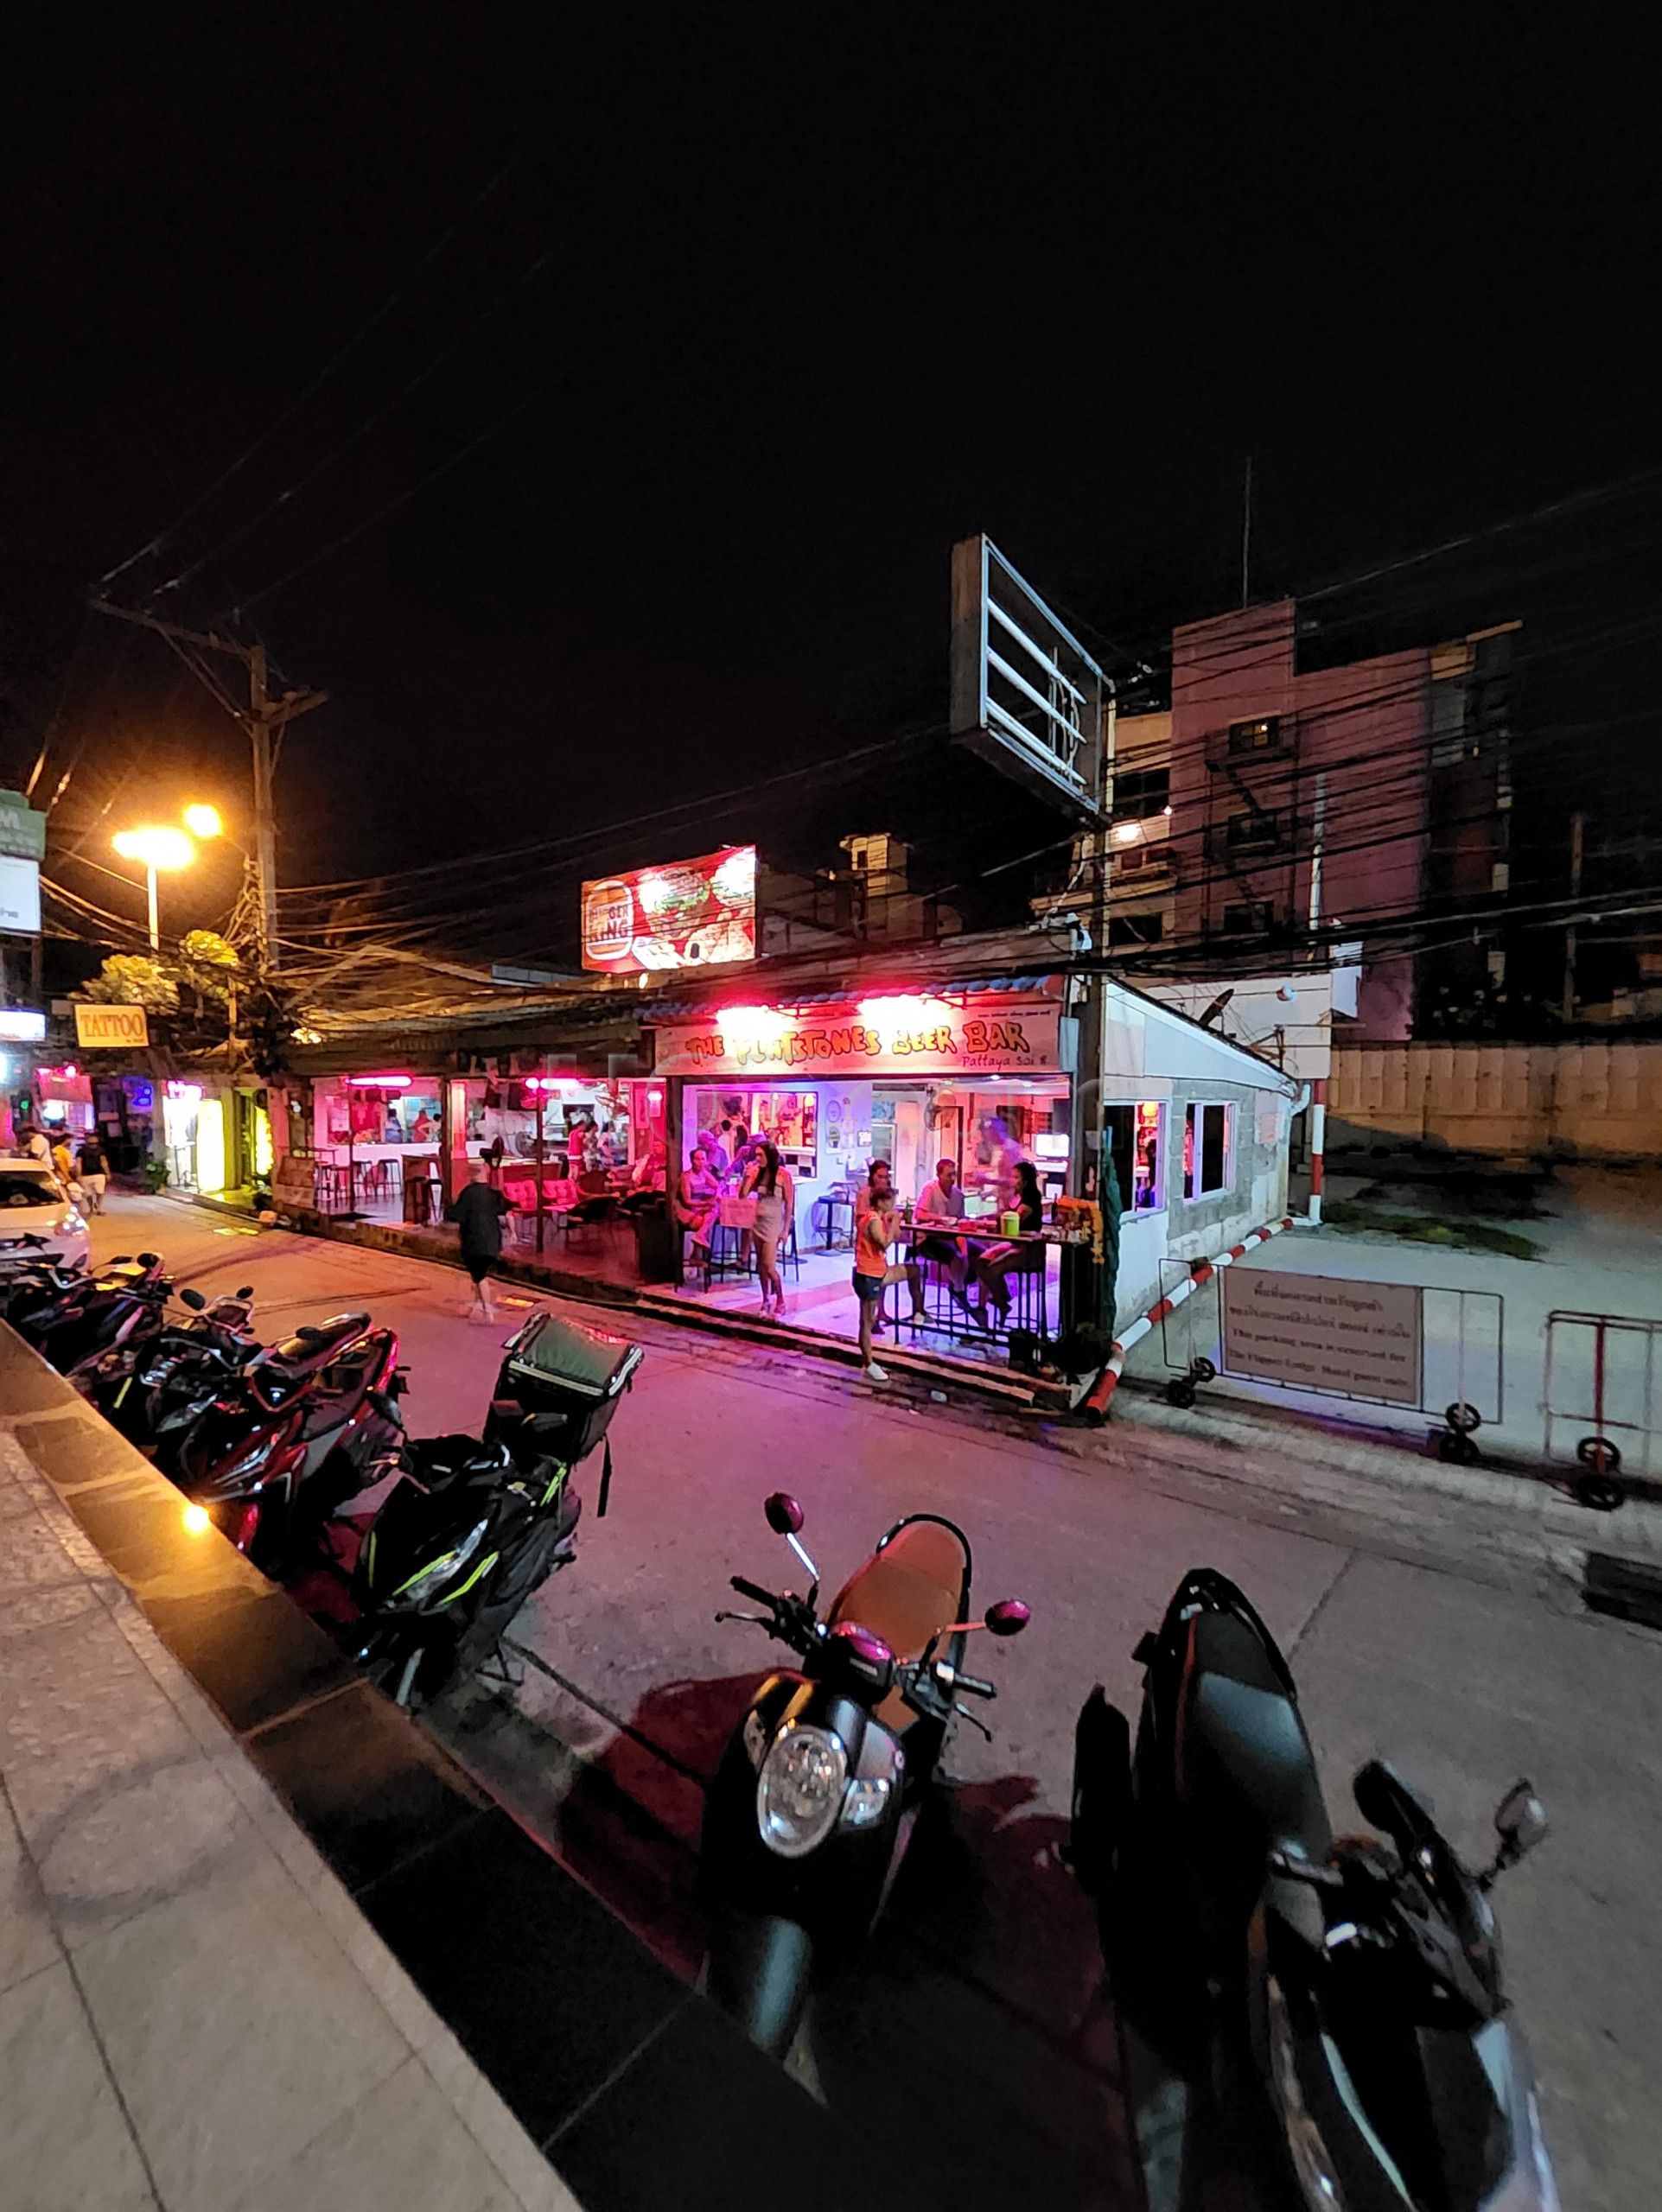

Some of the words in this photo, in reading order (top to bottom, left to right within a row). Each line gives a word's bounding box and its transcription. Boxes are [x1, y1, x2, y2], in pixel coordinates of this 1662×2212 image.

[80, 1014, 143, 1037] TATTOO
[685, 1035, 724, 1065] THE
[734, 1026, 882, 1065] FLNTSTONES
[892, 1026, 957, 1055] BEER
[963, 1020, 1030, 1053] BAR
[962, 1054, 1010, 1071] Pattaya
